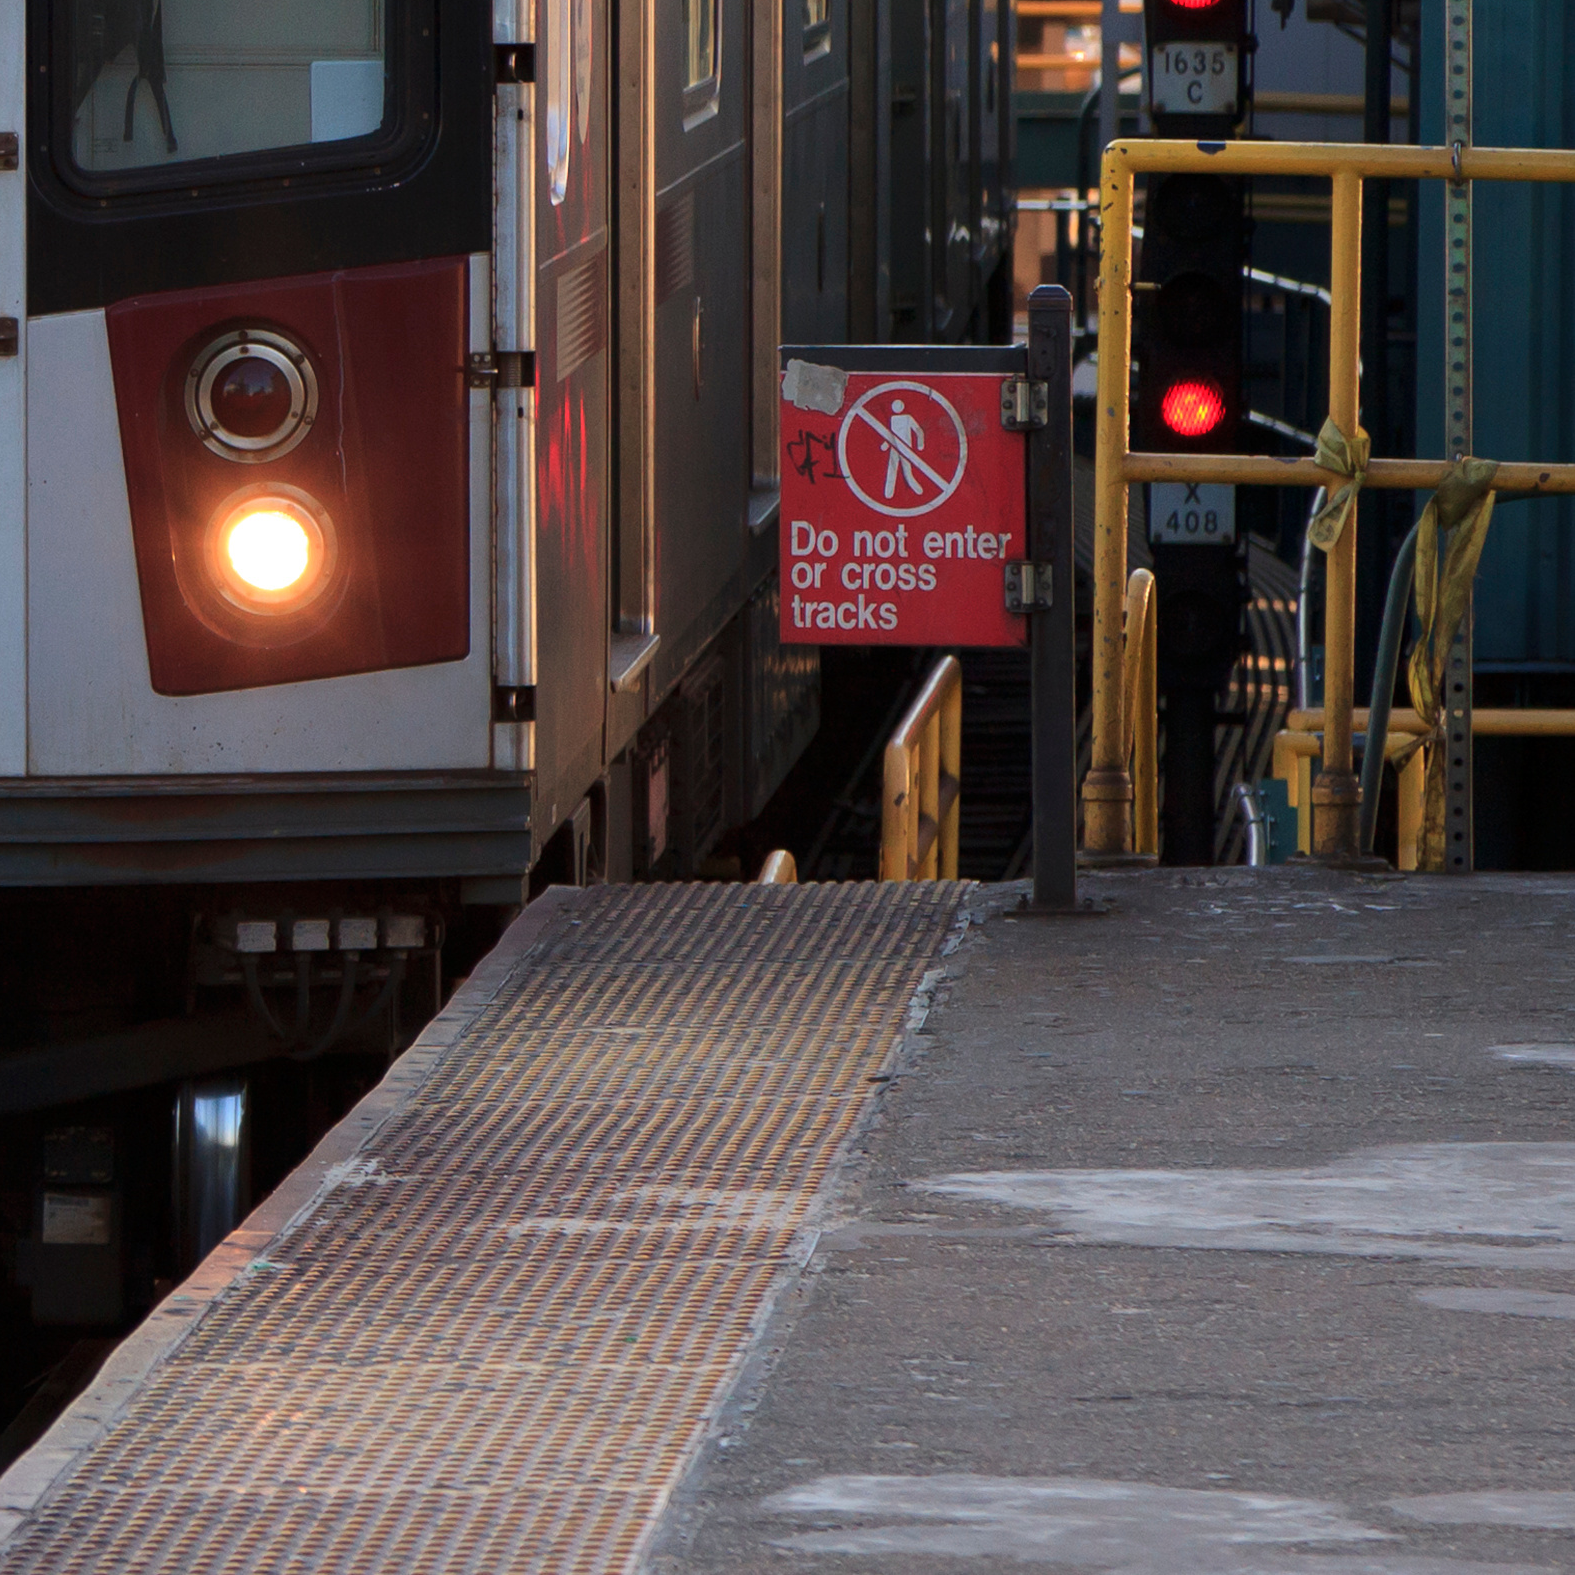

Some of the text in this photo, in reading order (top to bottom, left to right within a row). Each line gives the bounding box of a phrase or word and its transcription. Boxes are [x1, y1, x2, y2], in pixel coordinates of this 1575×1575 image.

[1164, 48, 1226, 75] 1635
[1187, 80, 1203, 104] C
[1167, 510, 1219, 535] 408
[790, 520, 1012, 560] Do not enter
[791, 560, 937, 591] or cross
[791, 593, 898, 630] tracks
